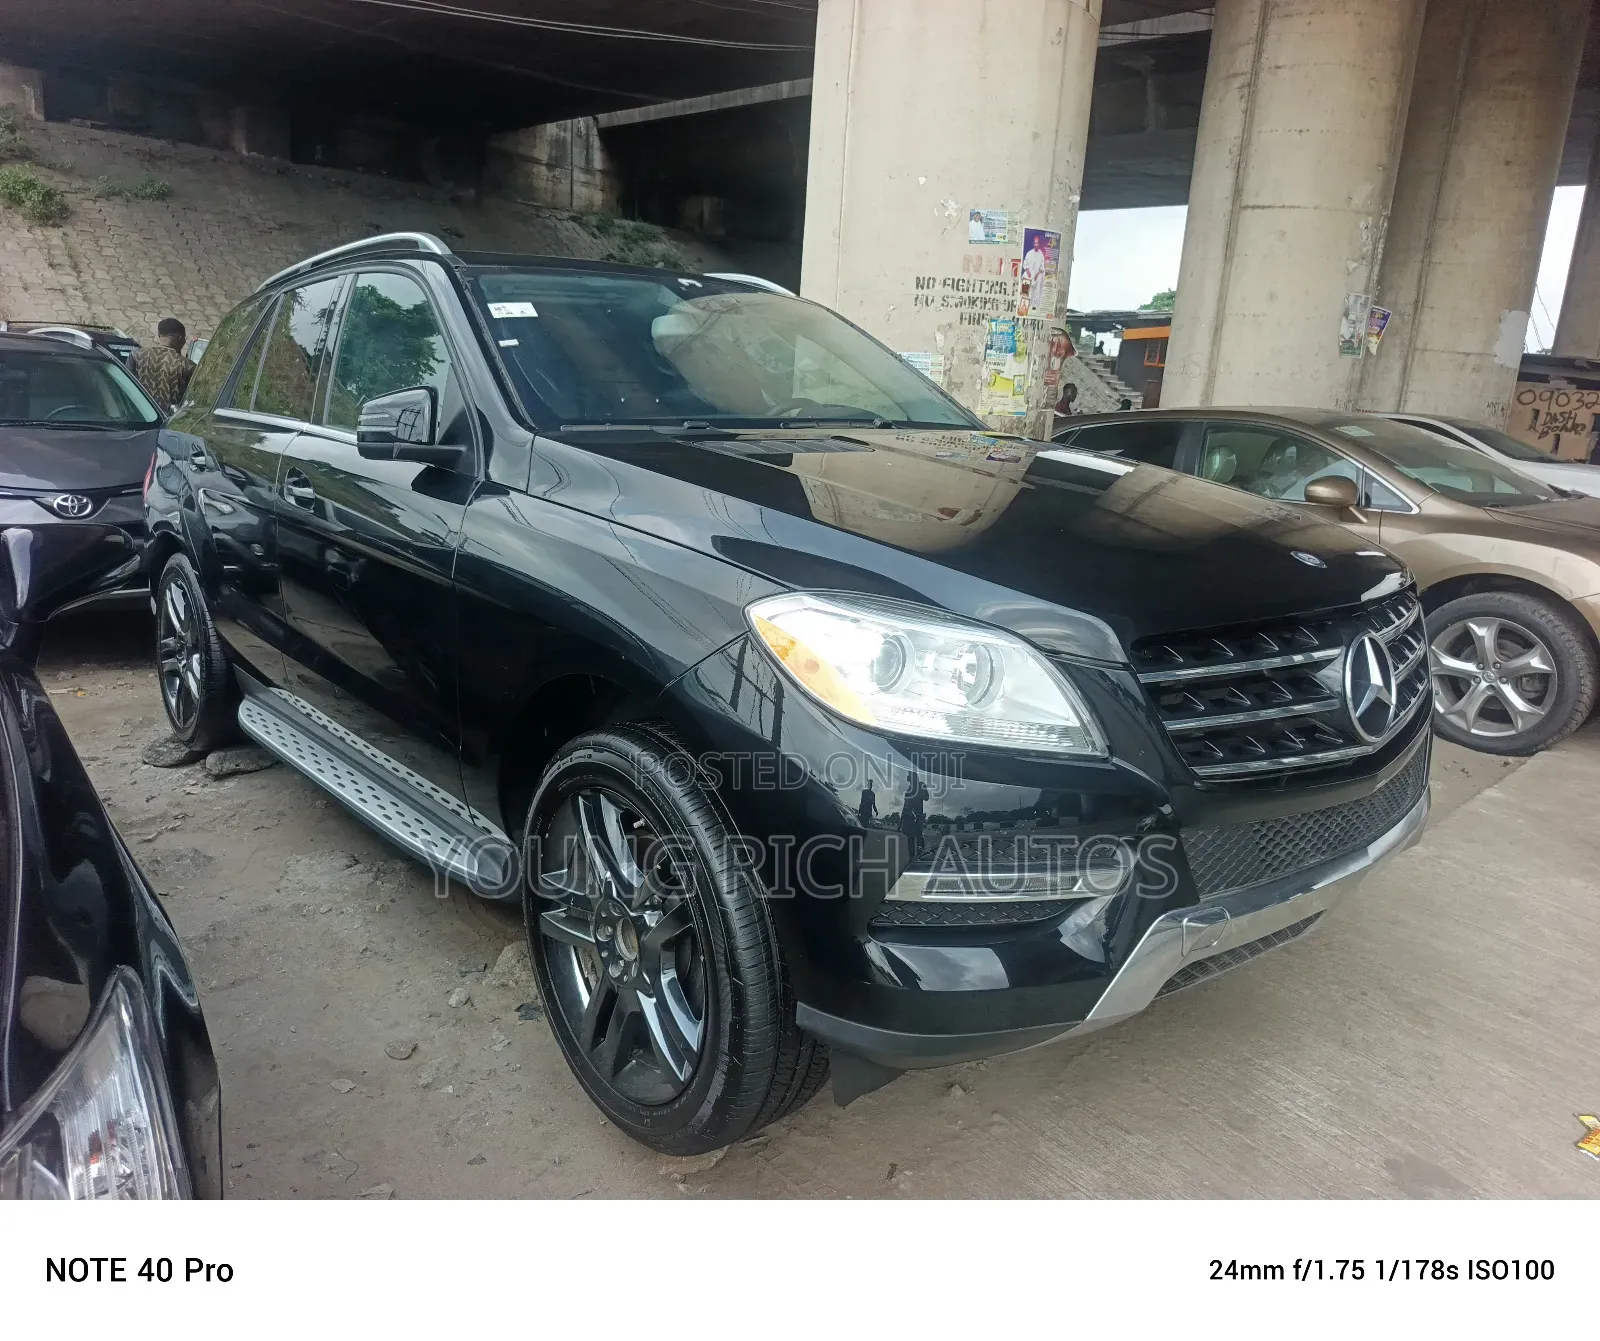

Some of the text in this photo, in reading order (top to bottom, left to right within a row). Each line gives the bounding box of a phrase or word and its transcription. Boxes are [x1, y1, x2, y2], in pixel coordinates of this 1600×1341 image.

[915, 276, 937, 291] NO
[913, 293, 935, 307] NO
[1517, 388, 1600, 411] 09032
[1540, 410, 1577, 426] DASH
[1538, 423, 1587, 440] BOARD
